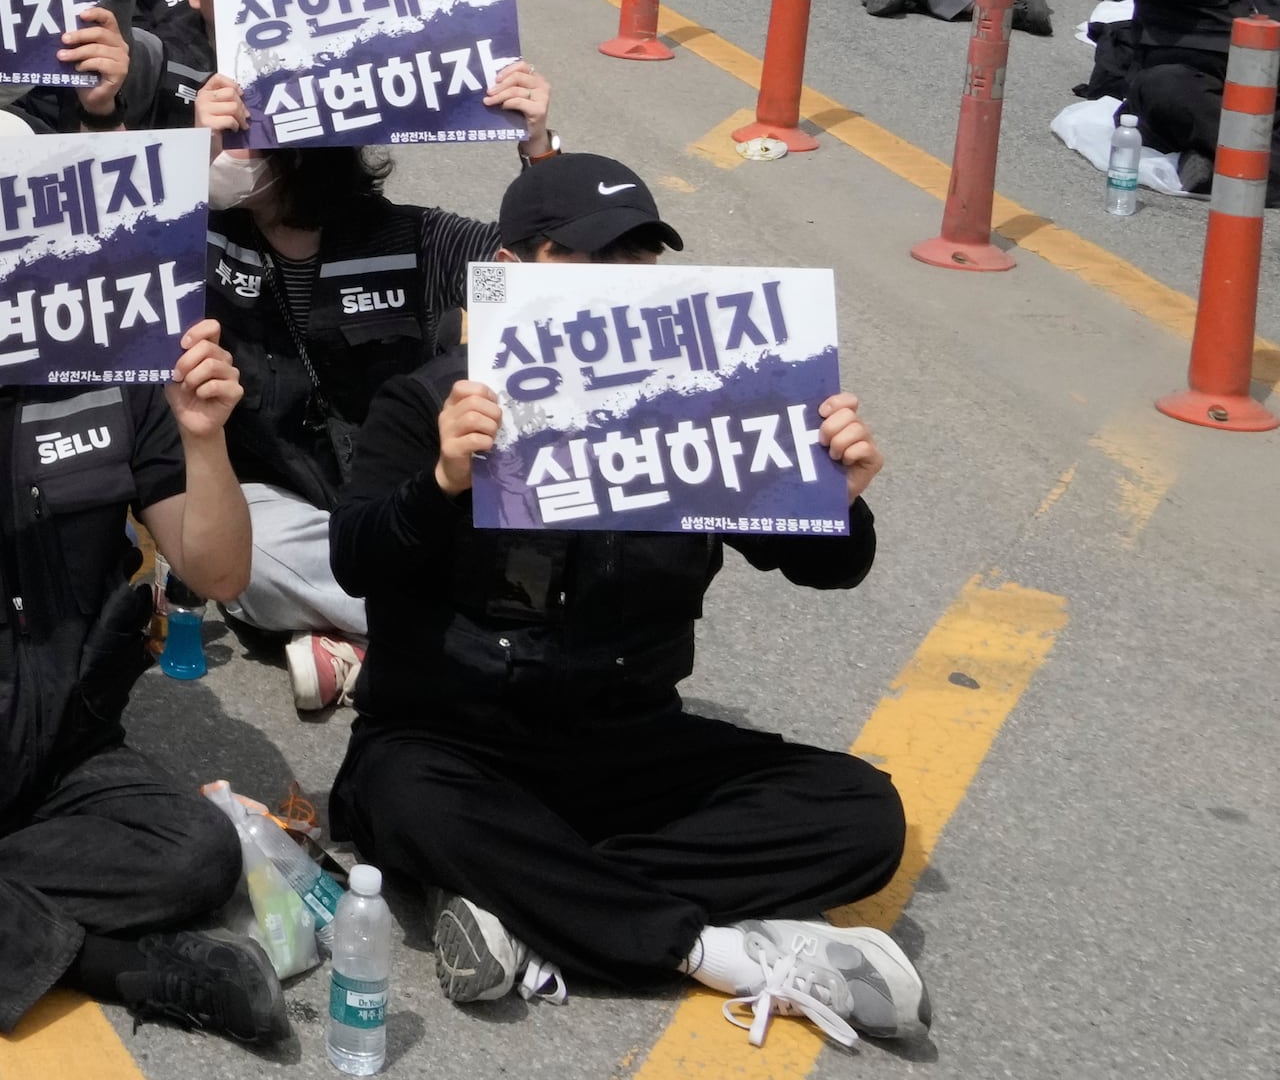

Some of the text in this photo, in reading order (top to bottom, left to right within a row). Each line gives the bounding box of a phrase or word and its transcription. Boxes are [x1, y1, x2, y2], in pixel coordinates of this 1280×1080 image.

[263, 38, 521, 143] 실현하자
[390, 128, 525, 144] 삼성전자노동조합 공동투쟁본부
[215, 261, 262, 297] 투쟁
[341, 288, 406, 315] SELU
[492, 281, 790, 402] 상한폐지
[47, 369, 136, 383] 삼성전자노동조합
[36, 426, 112, 464] SELU
[525, 404, 821, 524] 실현하자
[681, 516, 845, 534] 삼성전자노동조합 공동투쟁본부
